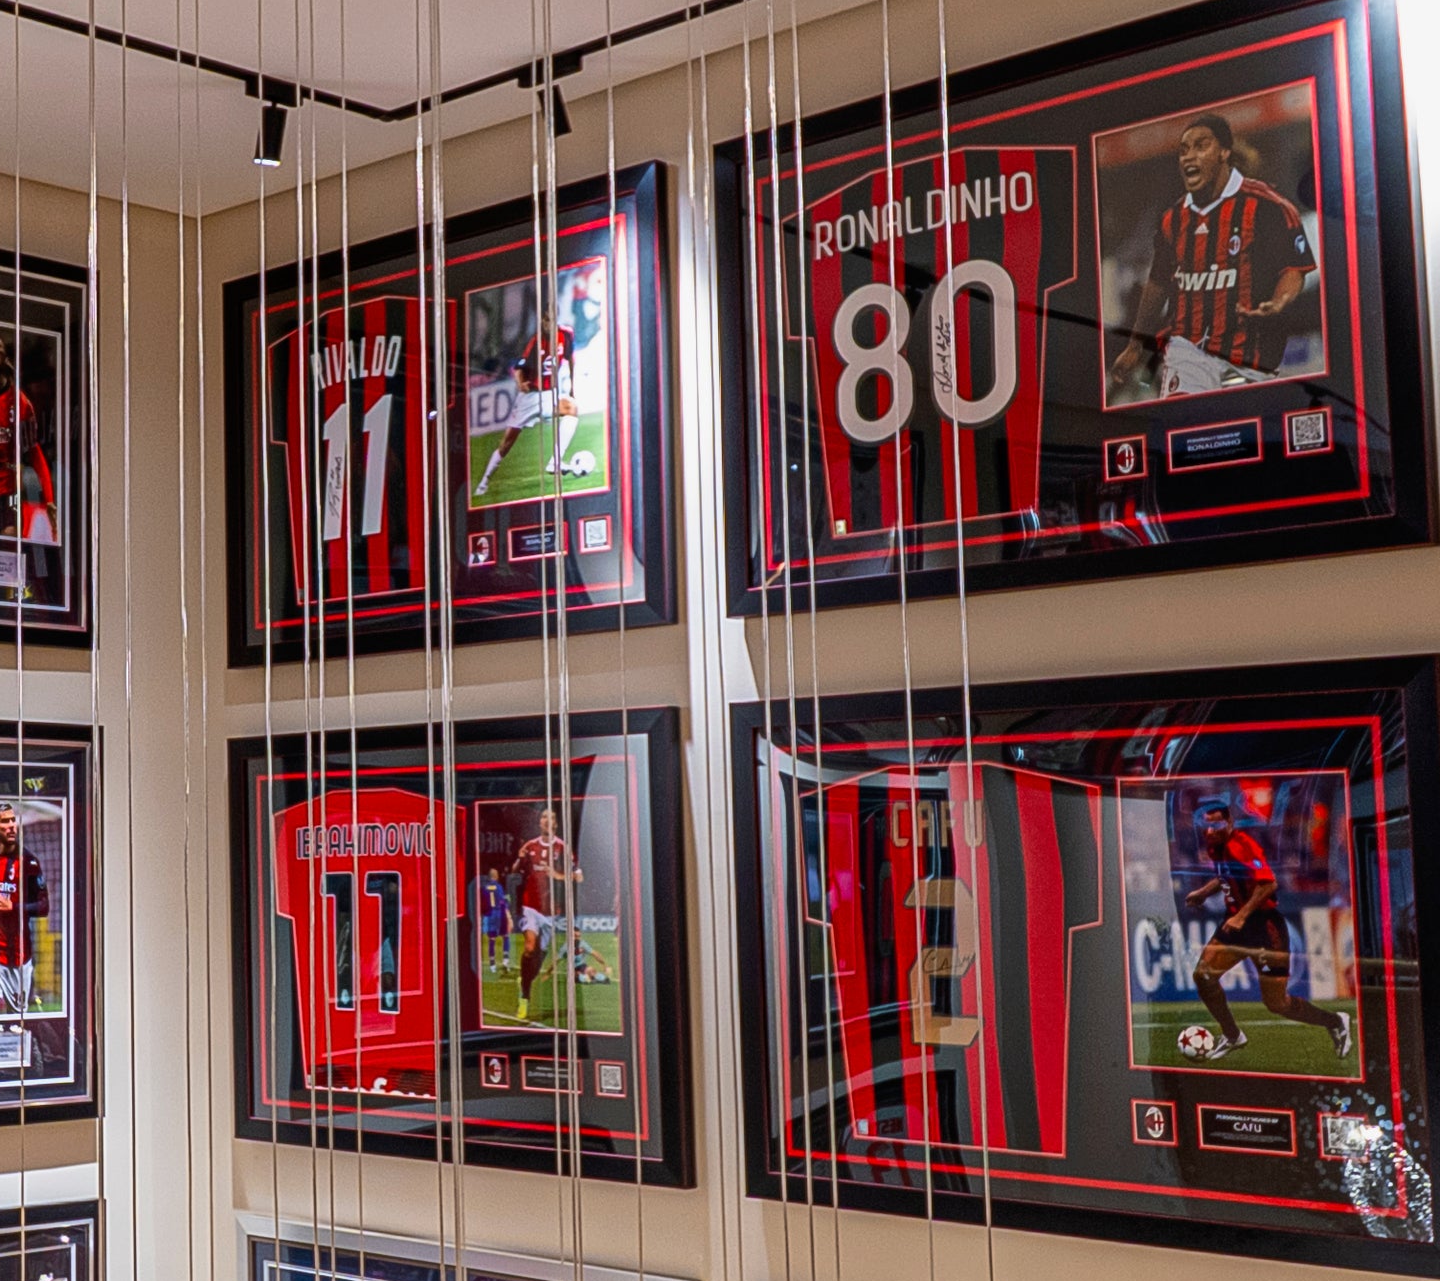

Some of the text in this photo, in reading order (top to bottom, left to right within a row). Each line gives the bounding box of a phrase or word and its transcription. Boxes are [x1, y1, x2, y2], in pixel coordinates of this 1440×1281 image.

[814, 171, 1034, 260] RONALDINHO
[310, 335, 402, 390] RIVALDO
[831, 259, 1017, 445] 80
[322, 393, 393, 541] 11
[1187, 438, 1241, 452] RONALDINHO
[891, 800, 985, 847] CAFU
[320, 871, 401, 1015] 11
[903, 878, 984, 1046] 2
[1233, 1122, 1262, 1133] CAFU
